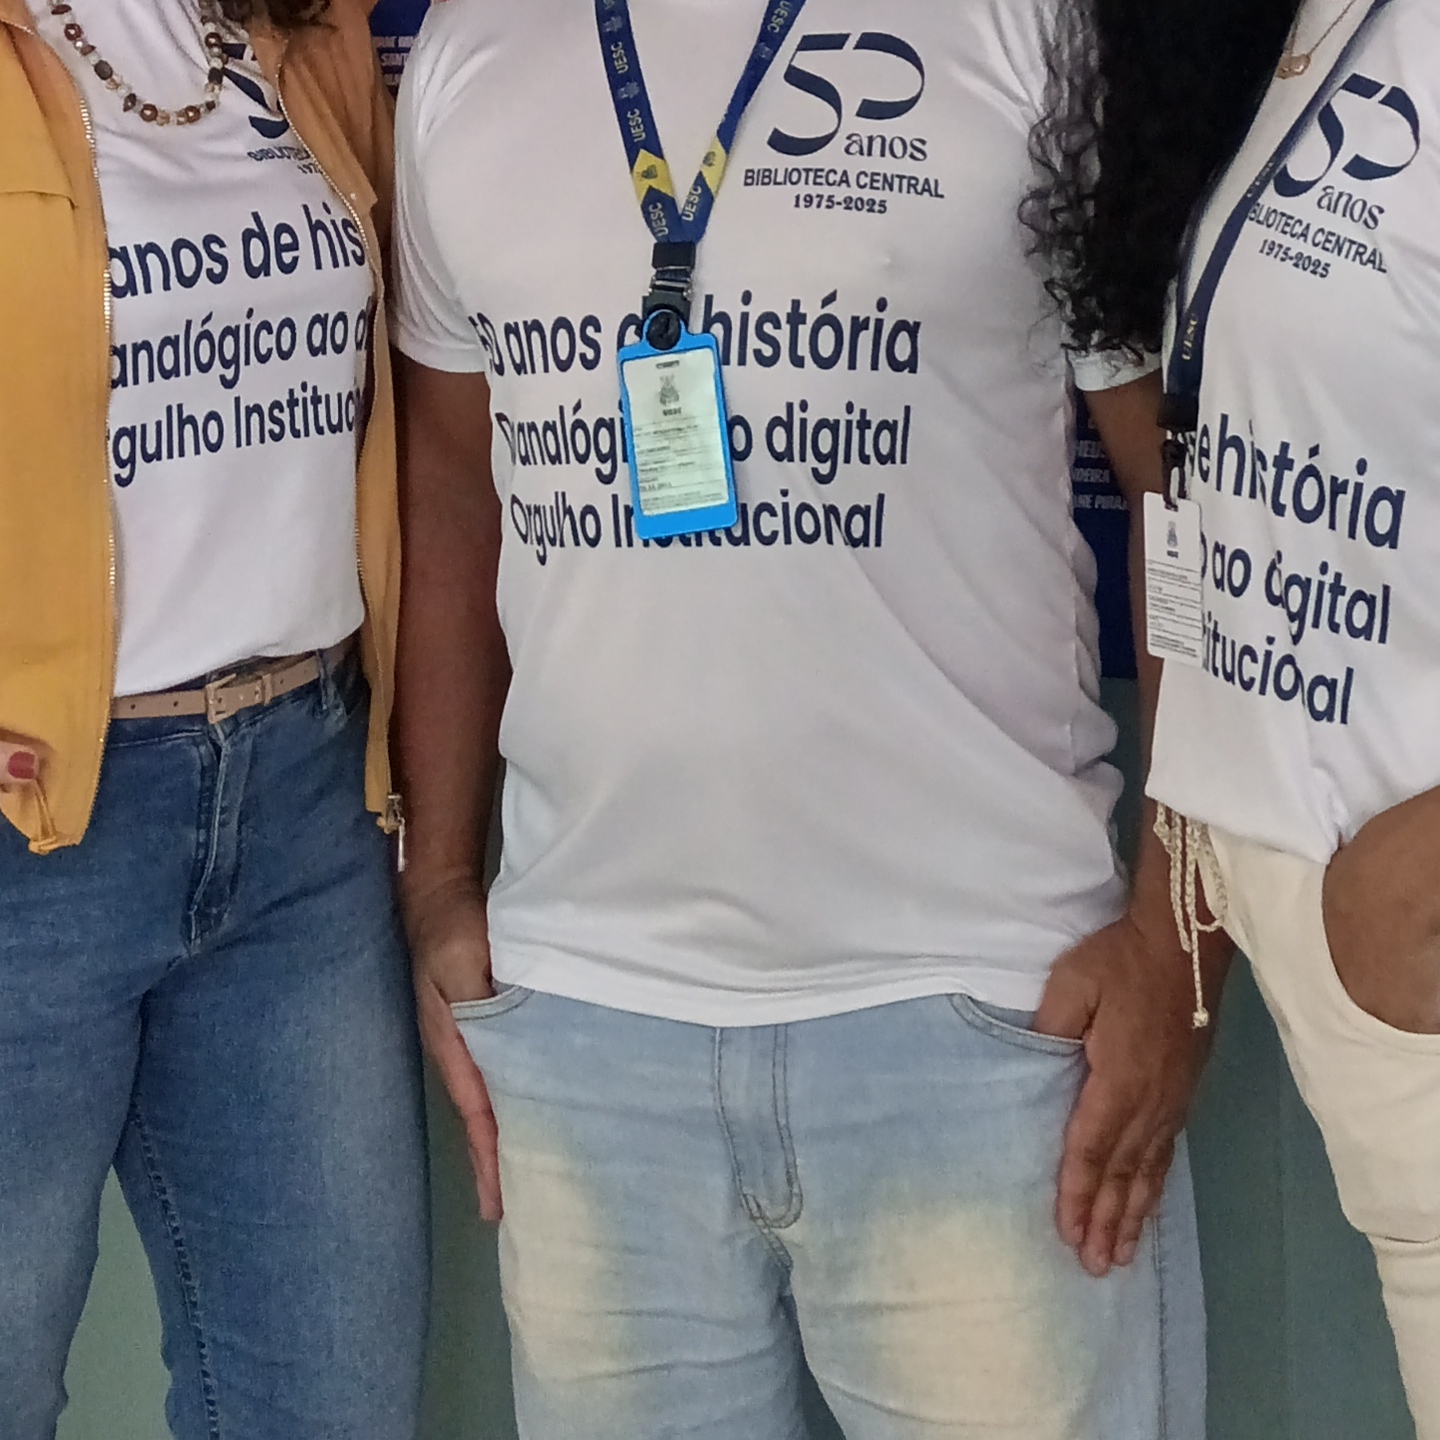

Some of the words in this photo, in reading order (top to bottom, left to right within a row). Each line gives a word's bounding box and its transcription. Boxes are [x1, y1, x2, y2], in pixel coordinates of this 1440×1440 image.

[767, 0, 791, 33] UESC
[611, 41, 629, 74] UESC
[767, 32, 926, 161] 50
[627, 108, 646, 143] UESC
[844, 134, 927, 161] anos
[682, 185, 702, 222] UESC
[744, 168, 851, 187] BIBLIOTECA
[855, 171, 944, 202] CENTRAL
[795, 194, 887, 214] 1975-2025
[648, 202, 668, 236] UESC
[1315, 186, 1384, 233] anos
[107, 234, 228, 298] anos
[242, 212, 299, 279] de
[1247, 203, 1311, 240] BLIOTECA
[1311, 227, 1388, 274] CENTRAL
[1259, 234, 1335, 278] 1975-2025
[110, 308, 296, 389] analógico
[307, 311, 348, 357] ao
[504, 315, 601, 376] anos
[698, 290, 921, 378] história
[113, 403, 224, 487] gulho
[233, 382, 361, 450] Instituc
[518, 394, 632, 489] analógi
[766, 400, 910, 484] digital
[511, 492, 601, 566] Orgulho
[612, 484, 885, 548] Inucional
[1213, 541, 1251, 597] ao
[1265, 549, 1391, 646] dgital
